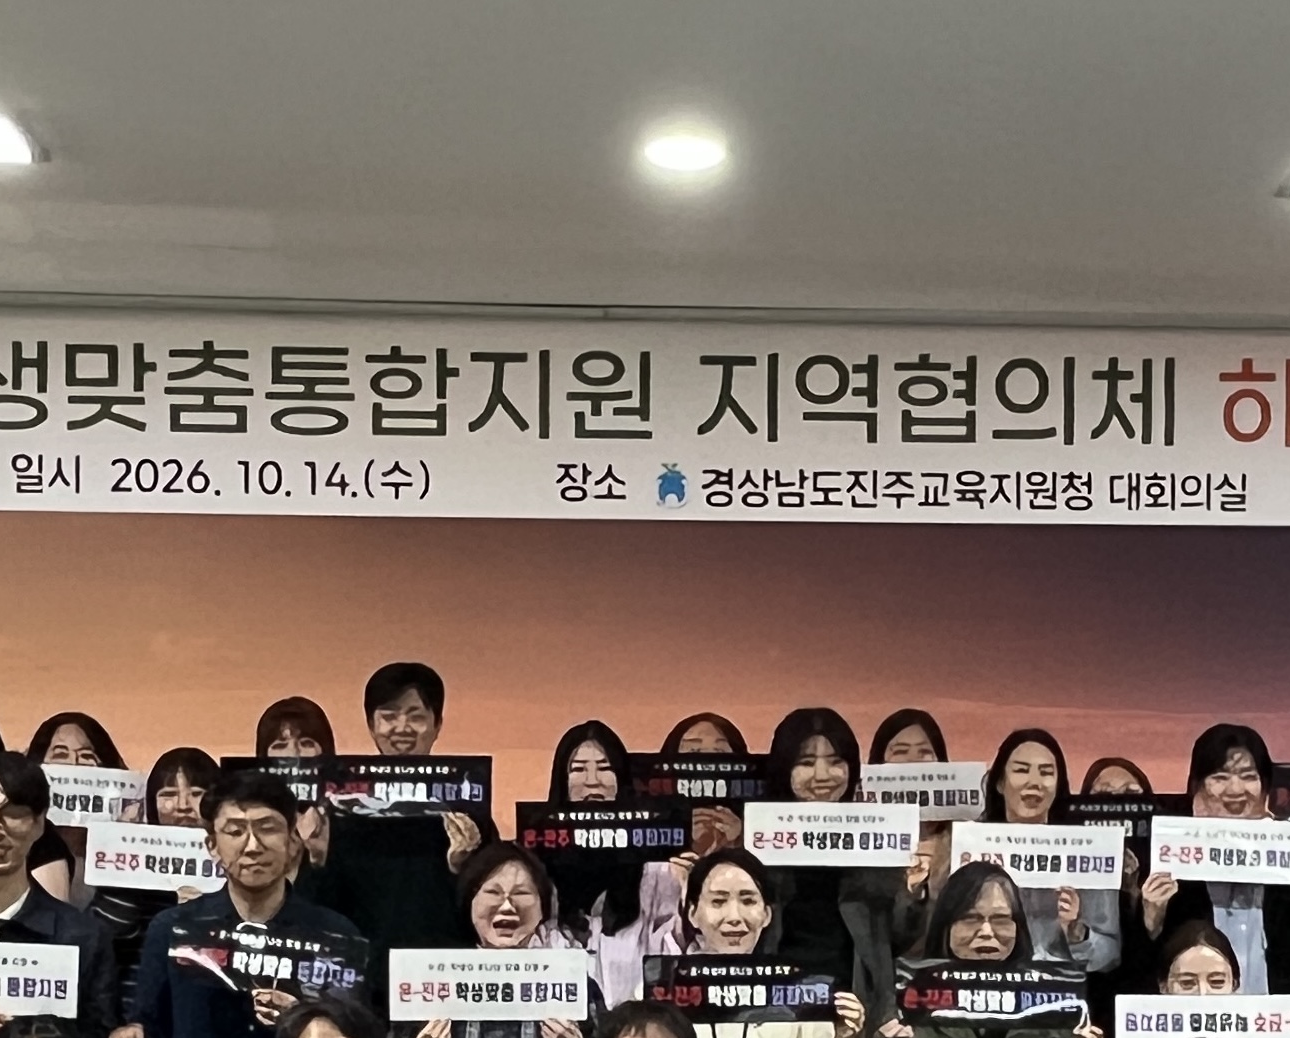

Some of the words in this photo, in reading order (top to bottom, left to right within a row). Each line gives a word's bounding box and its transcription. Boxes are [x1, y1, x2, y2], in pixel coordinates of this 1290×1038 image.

[695, 350, 1179, 446] 지역협의체
[11, 453, 83, 494] 일시
[555, 462, 628, 502] 장소
[700, 464, 1095, 510] 경상남도진주교육지원청
[1108, 470, 1249, 512] 대회의실
